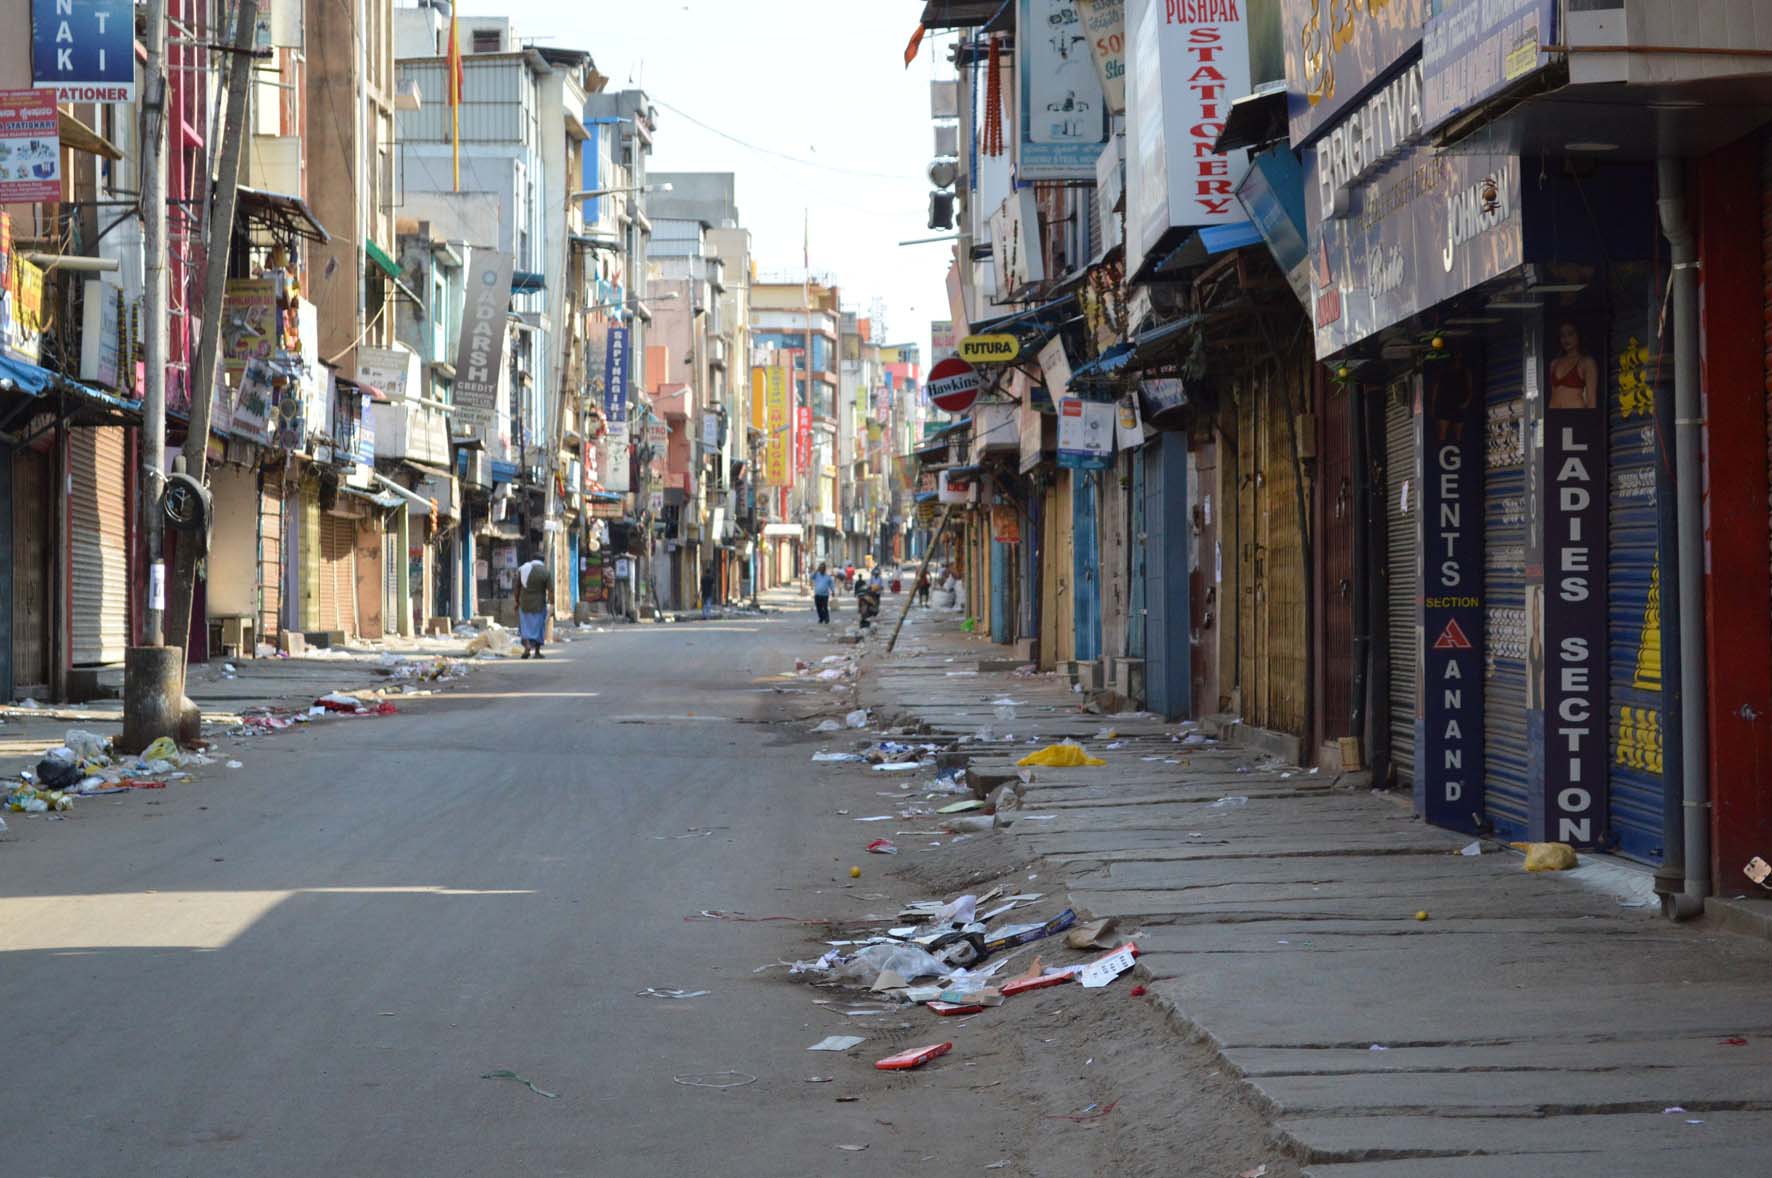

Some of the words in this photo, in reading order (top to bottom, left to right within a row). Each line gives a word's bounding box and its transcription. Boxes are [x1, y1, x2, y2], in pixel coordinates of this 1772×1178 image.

[1165, 0, 1240, 24] PUSHPAK
[1096, 31, 1125, 57] SO
[55, 87, 128, 101] ATIONER
[1185, 27, 1234, 215] STATIONERY
[467, 287, 498, 382] ADARSH
[964, 341, 1012, 356] FUTURA
[457, 382, 495, 393] CREDIT
[928, 376, 980, 397] Hawkins
[1437, 444, 1462, 588] GENTS
[1555, 427, 1591, 602] LADIES
[1425, 596, 1480, 609] SECTION
[1443, 658, 1464, 803] ANAND
[1557, 637, 1592, 844] SECTION
